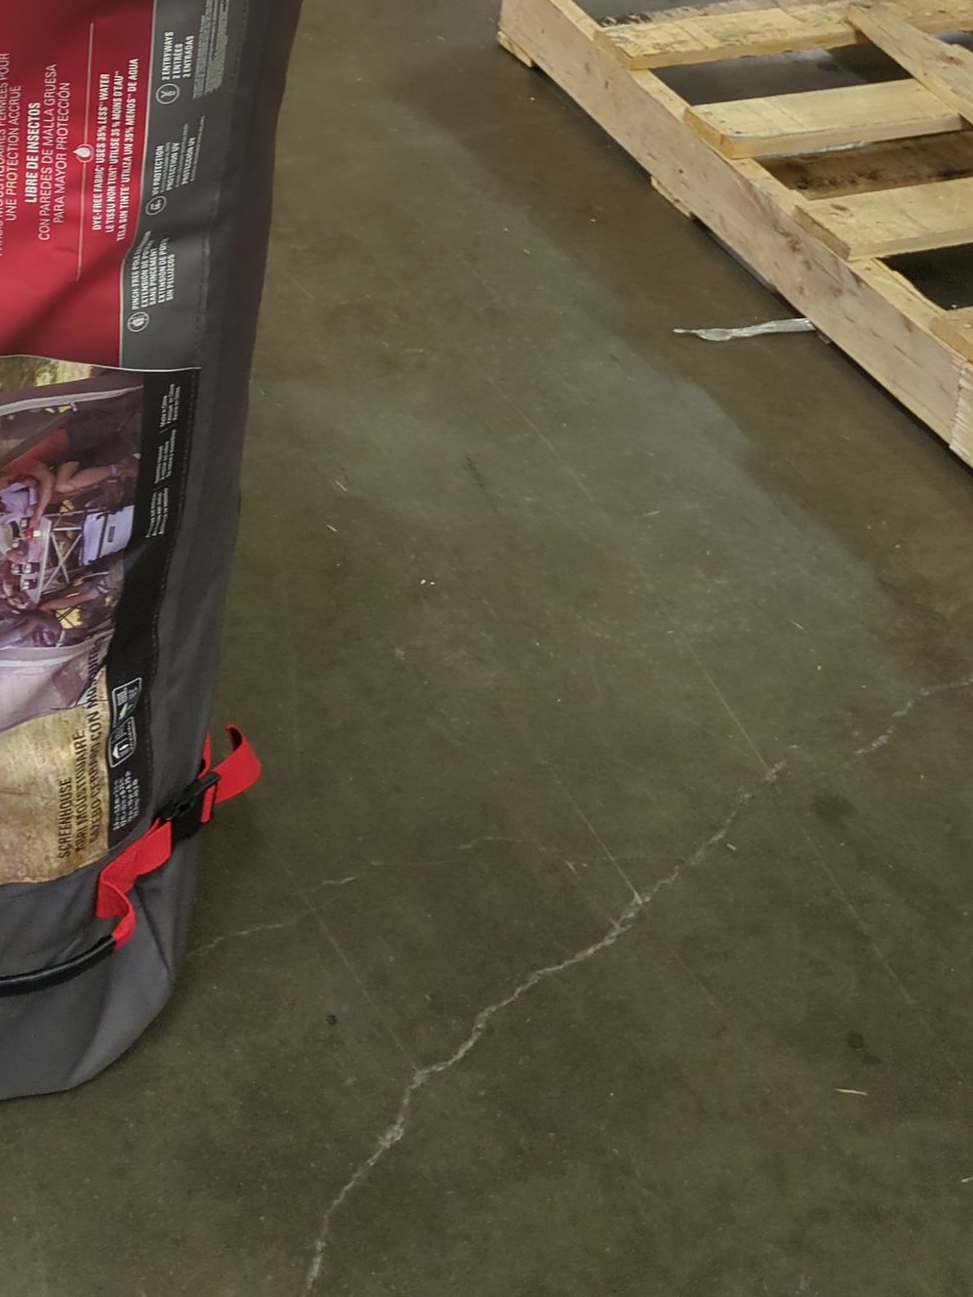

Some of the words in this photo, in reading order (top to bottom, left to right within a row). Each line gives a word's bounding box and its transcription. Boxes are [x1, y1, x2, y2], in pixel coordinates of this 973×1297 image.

[162, 31, 174, 75] ENTRYWAYS
[183, 35, 195, 73] ENTRADAS
[128, 58, 139, 80] AGUA
[43, 64, 57, 106] GRUESA
[99, 74, 110, 100] WATER
[127, 82, 137, 92] DE
[8, 86, 22, 125] ACCRUE
[54, 82, 70, 150] PROTECCIÓN
[112, 98, 122, 120] MOINS
[26, 102, 41, 153] INSECTOS
[42, 108, 55, 146] MALLA
[97, 126, 107, 141] 35%
[111, 128, 120, 137] 35
[124, 127, 134, 142] 35%
[6, 128, 20, 196] PROTECTION
[26, 155, 39, 169] DE
[41, 149, 53, 164] DE
[96, 143, 106, 164] USES
[109, 138, 120, 164] UTILISE
[123, 143, 133, 155] UN
[53, 152, 67, 193] MAYOR
[122, 156, 133, 183] UTILIZA
[152, 145, 165, 186] PROTECTION
[166, 152, 178, 191] PROTECTION
[24, 172, 38, 203] LIBRE
[39, 167, 53, 216] PAREDES
[107, 186, 116, 202] NON
[5, 199, 18, 221] UNE
[52, 196, 65, 223] PARA
[92, 194, 103, 230] DYE-FREE
[106, 203, 116, 224] TISSU
[117, 210, 128, 223] SIN
[38, 218, 50, 240] CON
[105, 225, 114, 233] LE
[116, 223, 126, 241] TELA
[131, 271, 140, 310] PINCH-FREE
[87, 711, 102, 738] CON
[72, 729, 88, 824] MOUSTIQUAIRE
[58, 777, 72, 858] SCREENHOUSE
